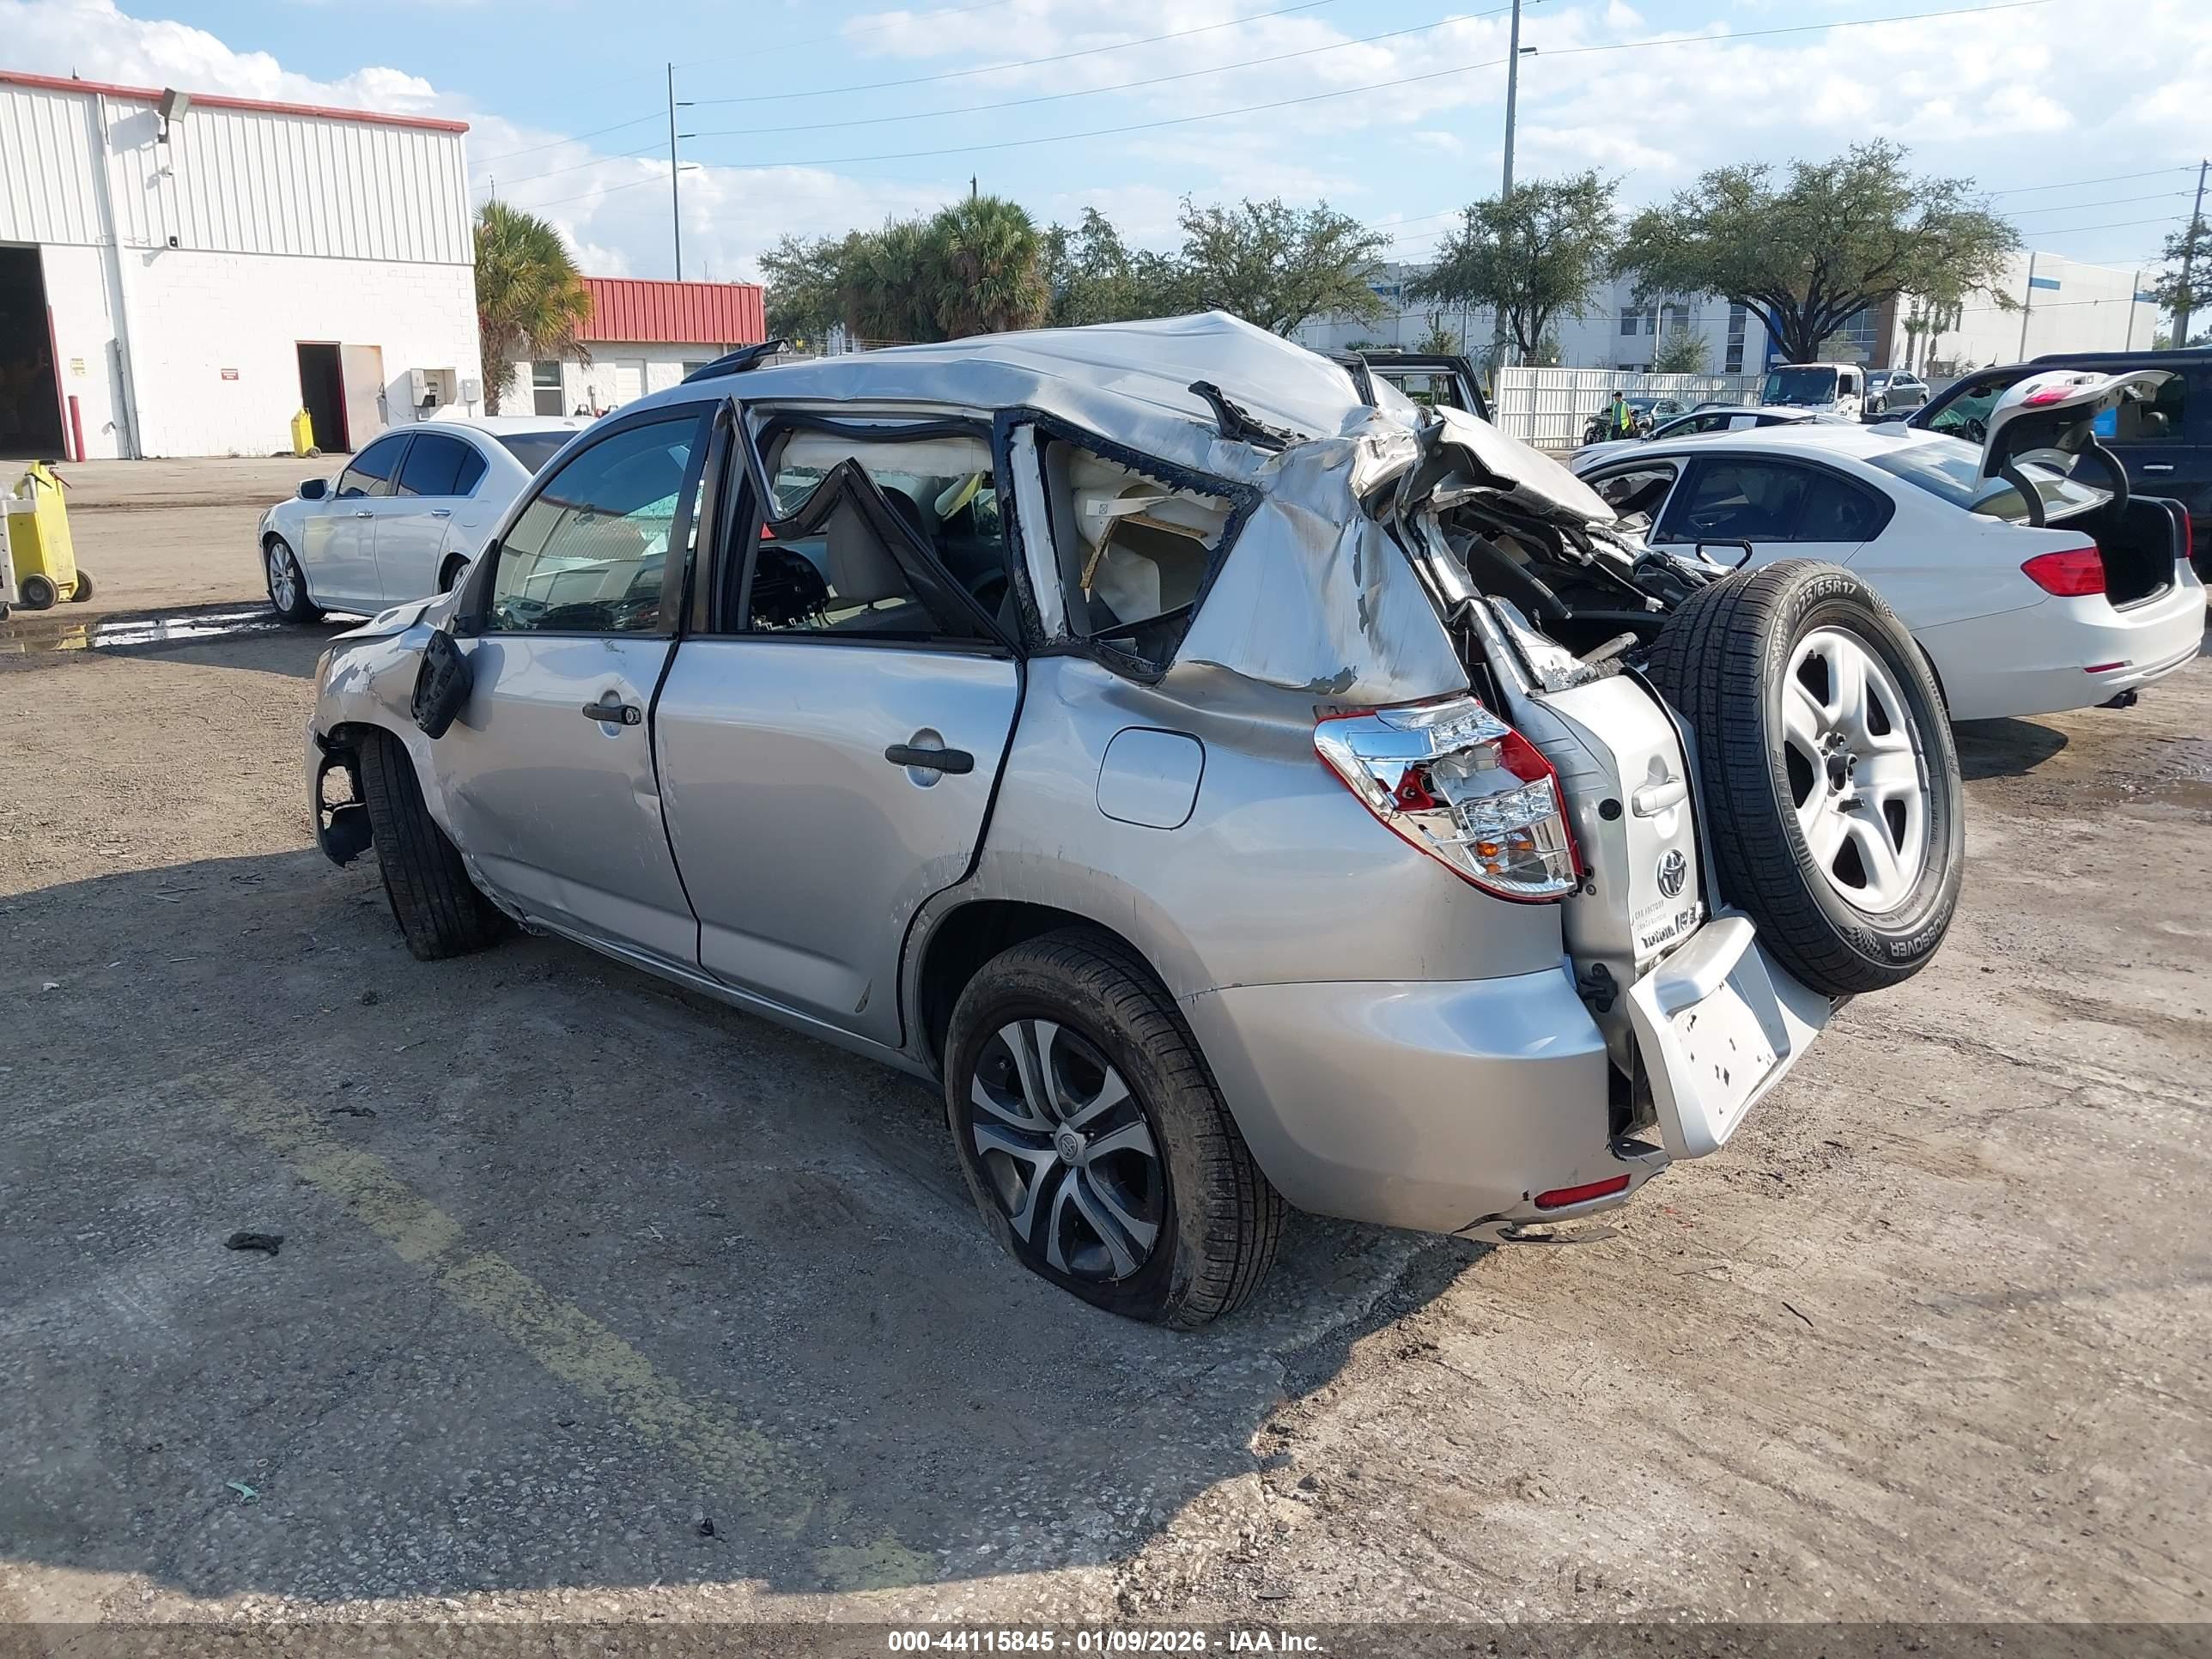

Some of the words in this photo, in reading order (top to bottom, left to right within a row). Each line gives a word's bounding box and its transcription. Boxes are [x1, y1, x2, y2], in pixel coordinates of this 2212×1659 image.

[1793, 580, 1856, 623] 225/65R17
[1771, 750, 1804, 846] MOHAVE
[1641, 925, 1675, 949] TOYOTA
[1889, 899, 1953, 957] CROSSOVER
